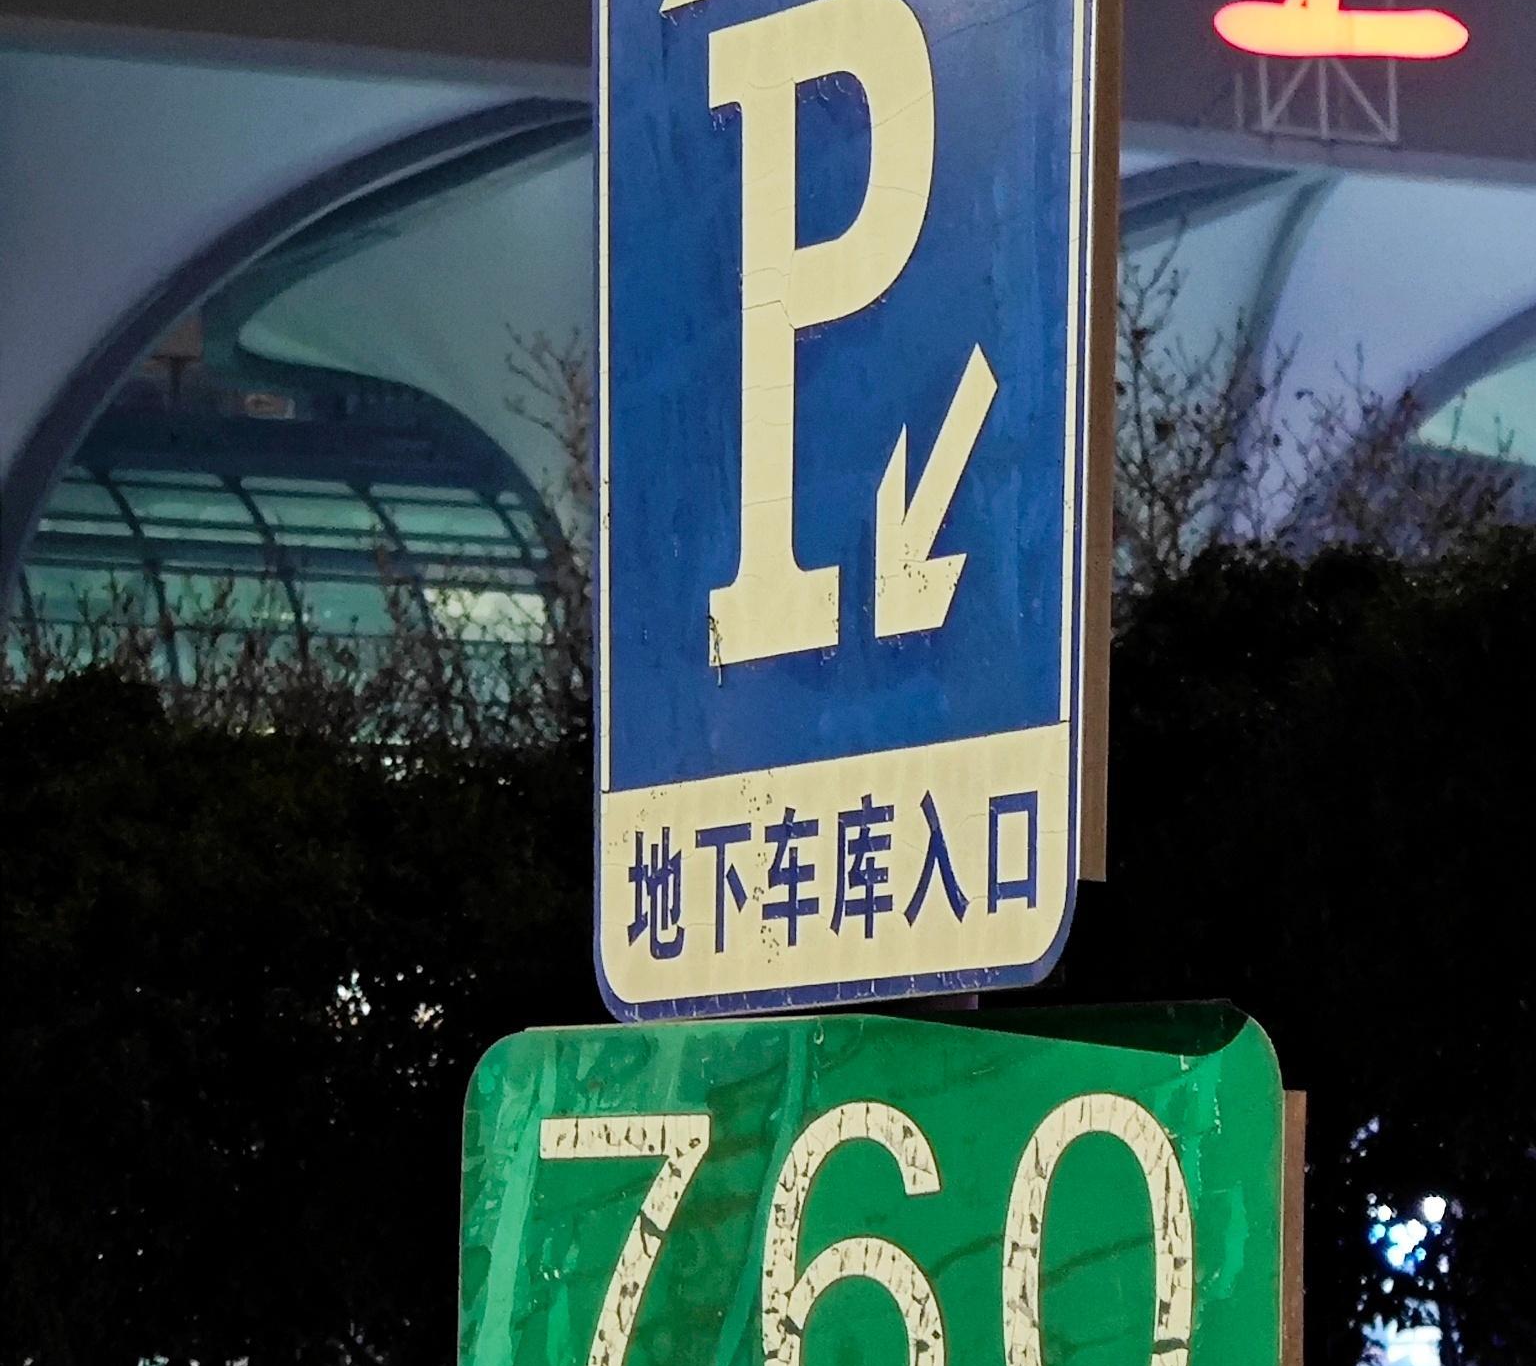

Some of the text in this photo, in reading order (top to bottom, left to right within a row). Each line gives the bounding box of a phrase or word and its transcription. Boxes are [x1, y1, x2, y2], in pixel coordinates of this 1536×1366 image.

[627, 790, 1038, 959] 地下车库入口
